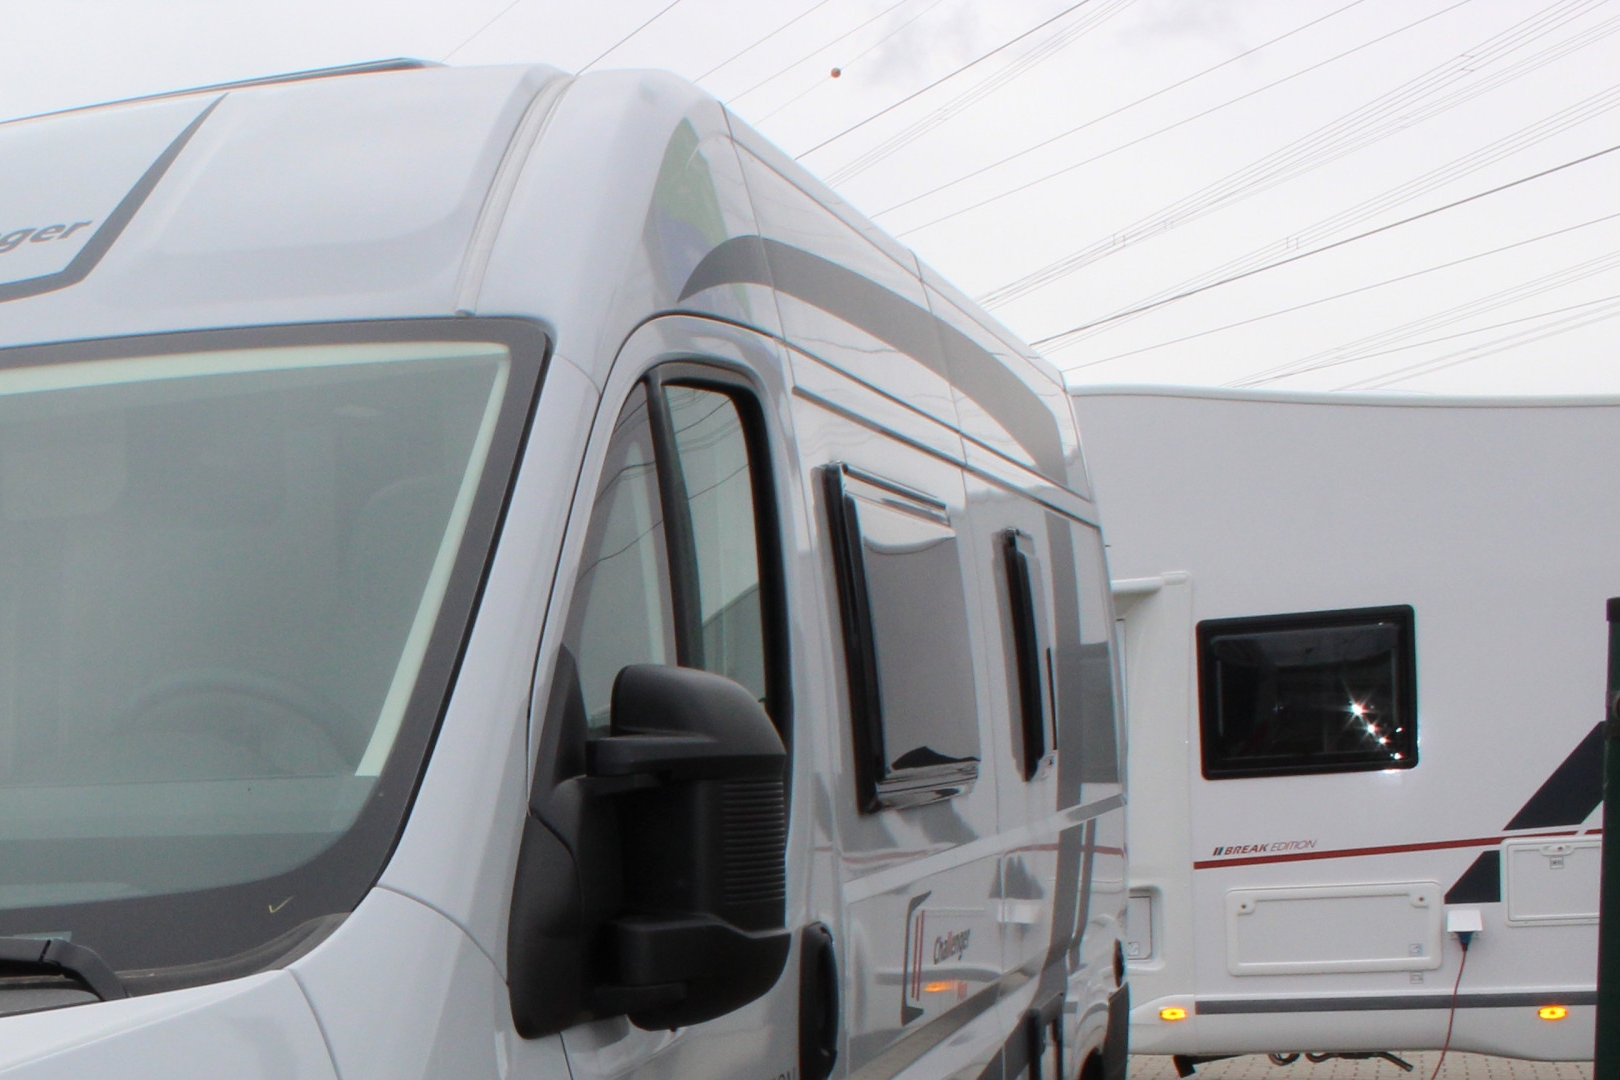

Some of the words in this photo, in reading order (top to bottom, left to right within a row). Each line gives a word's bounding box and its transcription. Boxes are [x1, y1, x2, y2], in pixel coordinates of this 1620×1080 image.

[1224, 843, 1268, 856] BREAK
[1270, 839, 1318, 852] EDITION
[933, 928, 971, 965] Challenger
